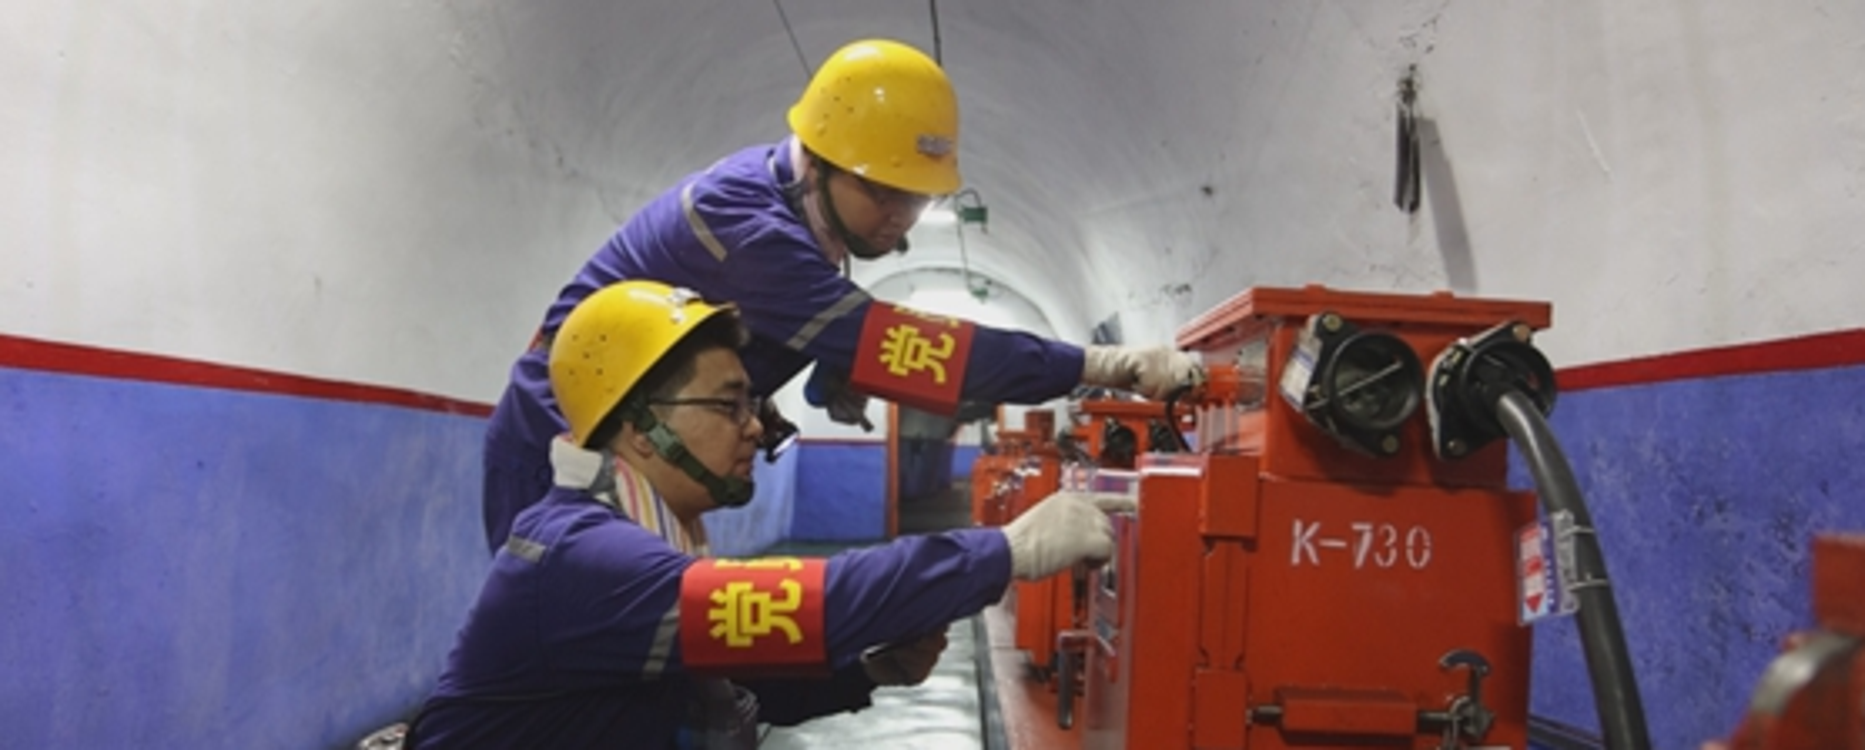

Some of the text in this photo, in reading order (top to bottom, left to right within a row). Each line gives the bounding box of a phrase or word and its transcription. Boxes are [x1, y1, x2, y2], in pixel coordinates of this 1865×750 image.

[878, 304, 961, 384] 党
[1291, 518, 1432, 570] K-730
[708, 557, 803, 645] 党
